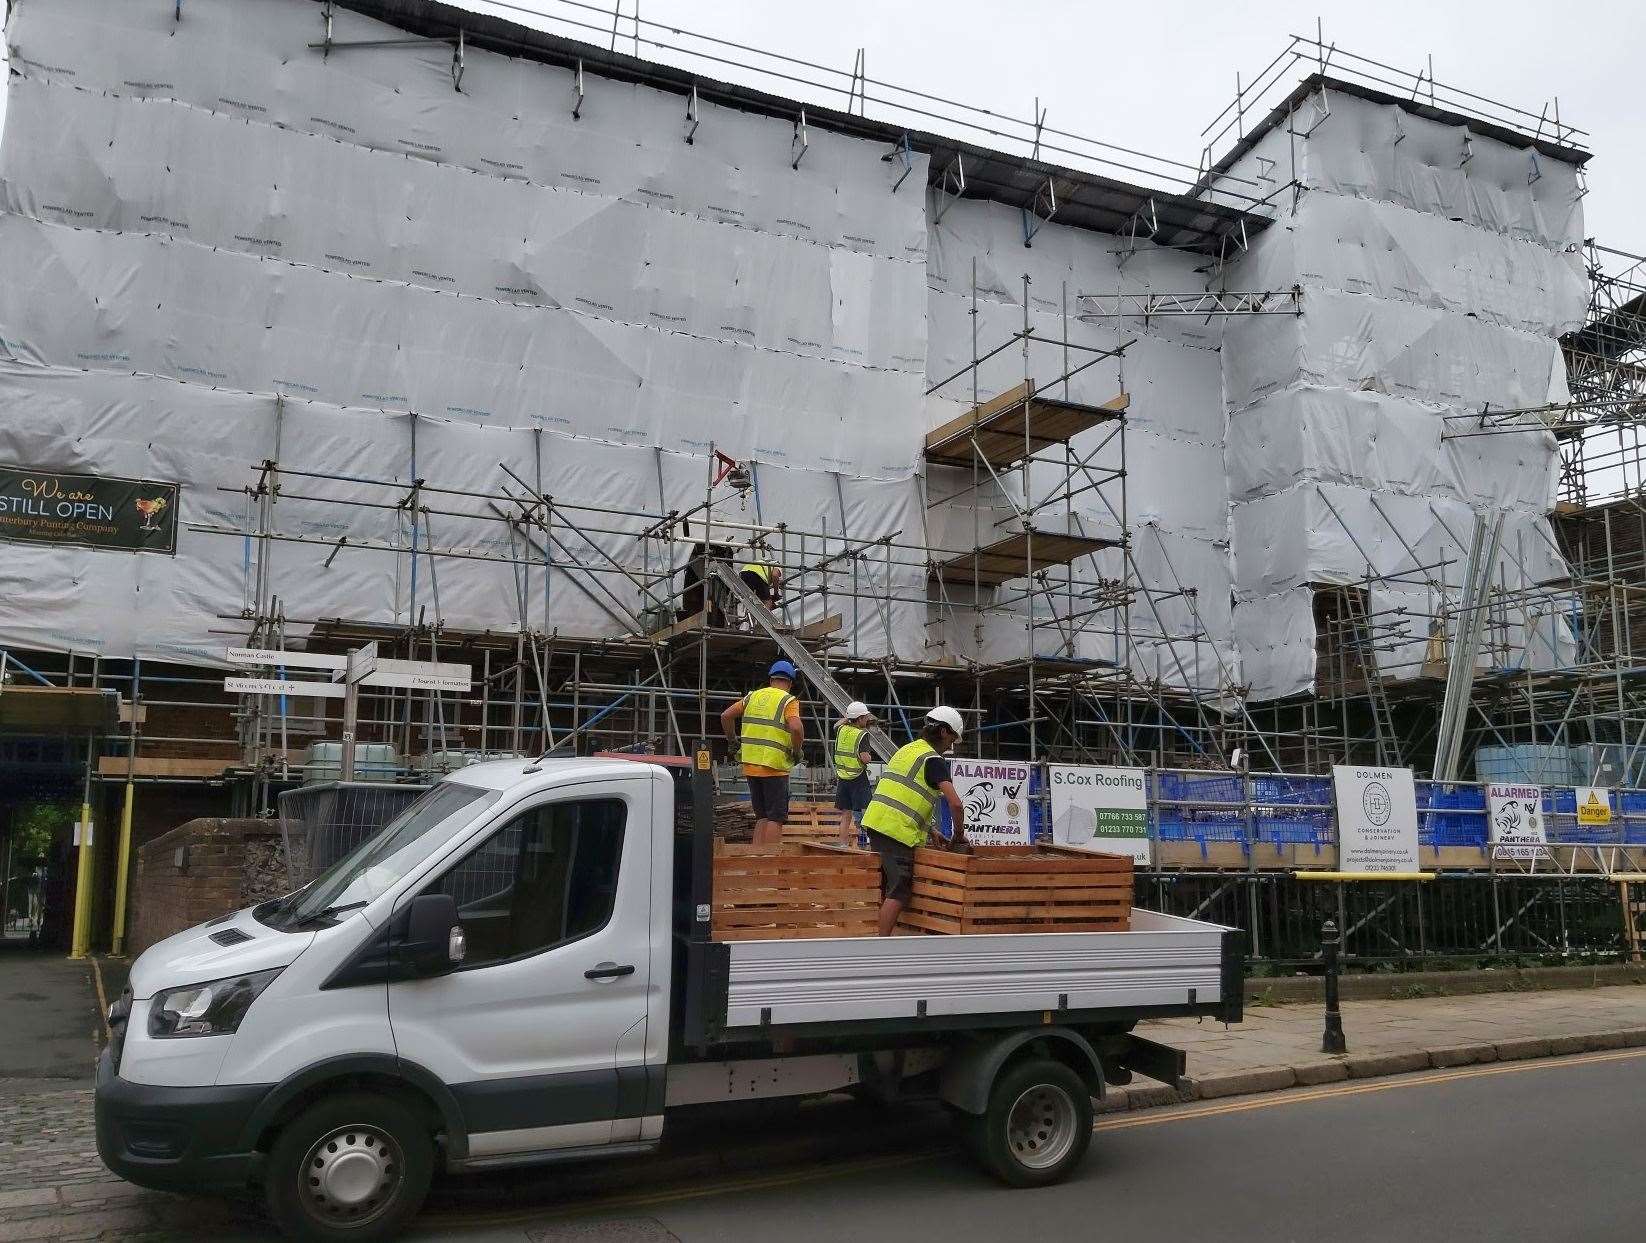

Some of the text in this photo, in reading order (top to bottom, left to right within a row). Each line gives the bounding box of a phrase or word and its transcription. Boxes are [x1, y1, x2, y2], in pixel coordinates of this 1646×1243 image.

[22, 479, 94, 501] We are
[0, 495, 112, 521] STILL OPEN
[77, 521, 119, 535] Company
[954, 765, 1028, 780] ALARMED
[1356, 771, 1393, 780] DOLMEN
[1054, 772, 1142, 790] S.Cox Roofing
[1491, 787, 1540, 799] ALARMED
[1099, 812, 1120, 821] 07766
[1581, 806, 1609, 818] Danger
[963, 823, 1021, 834] PANTHERA
[1100, 825, 1121, 833] 01233
